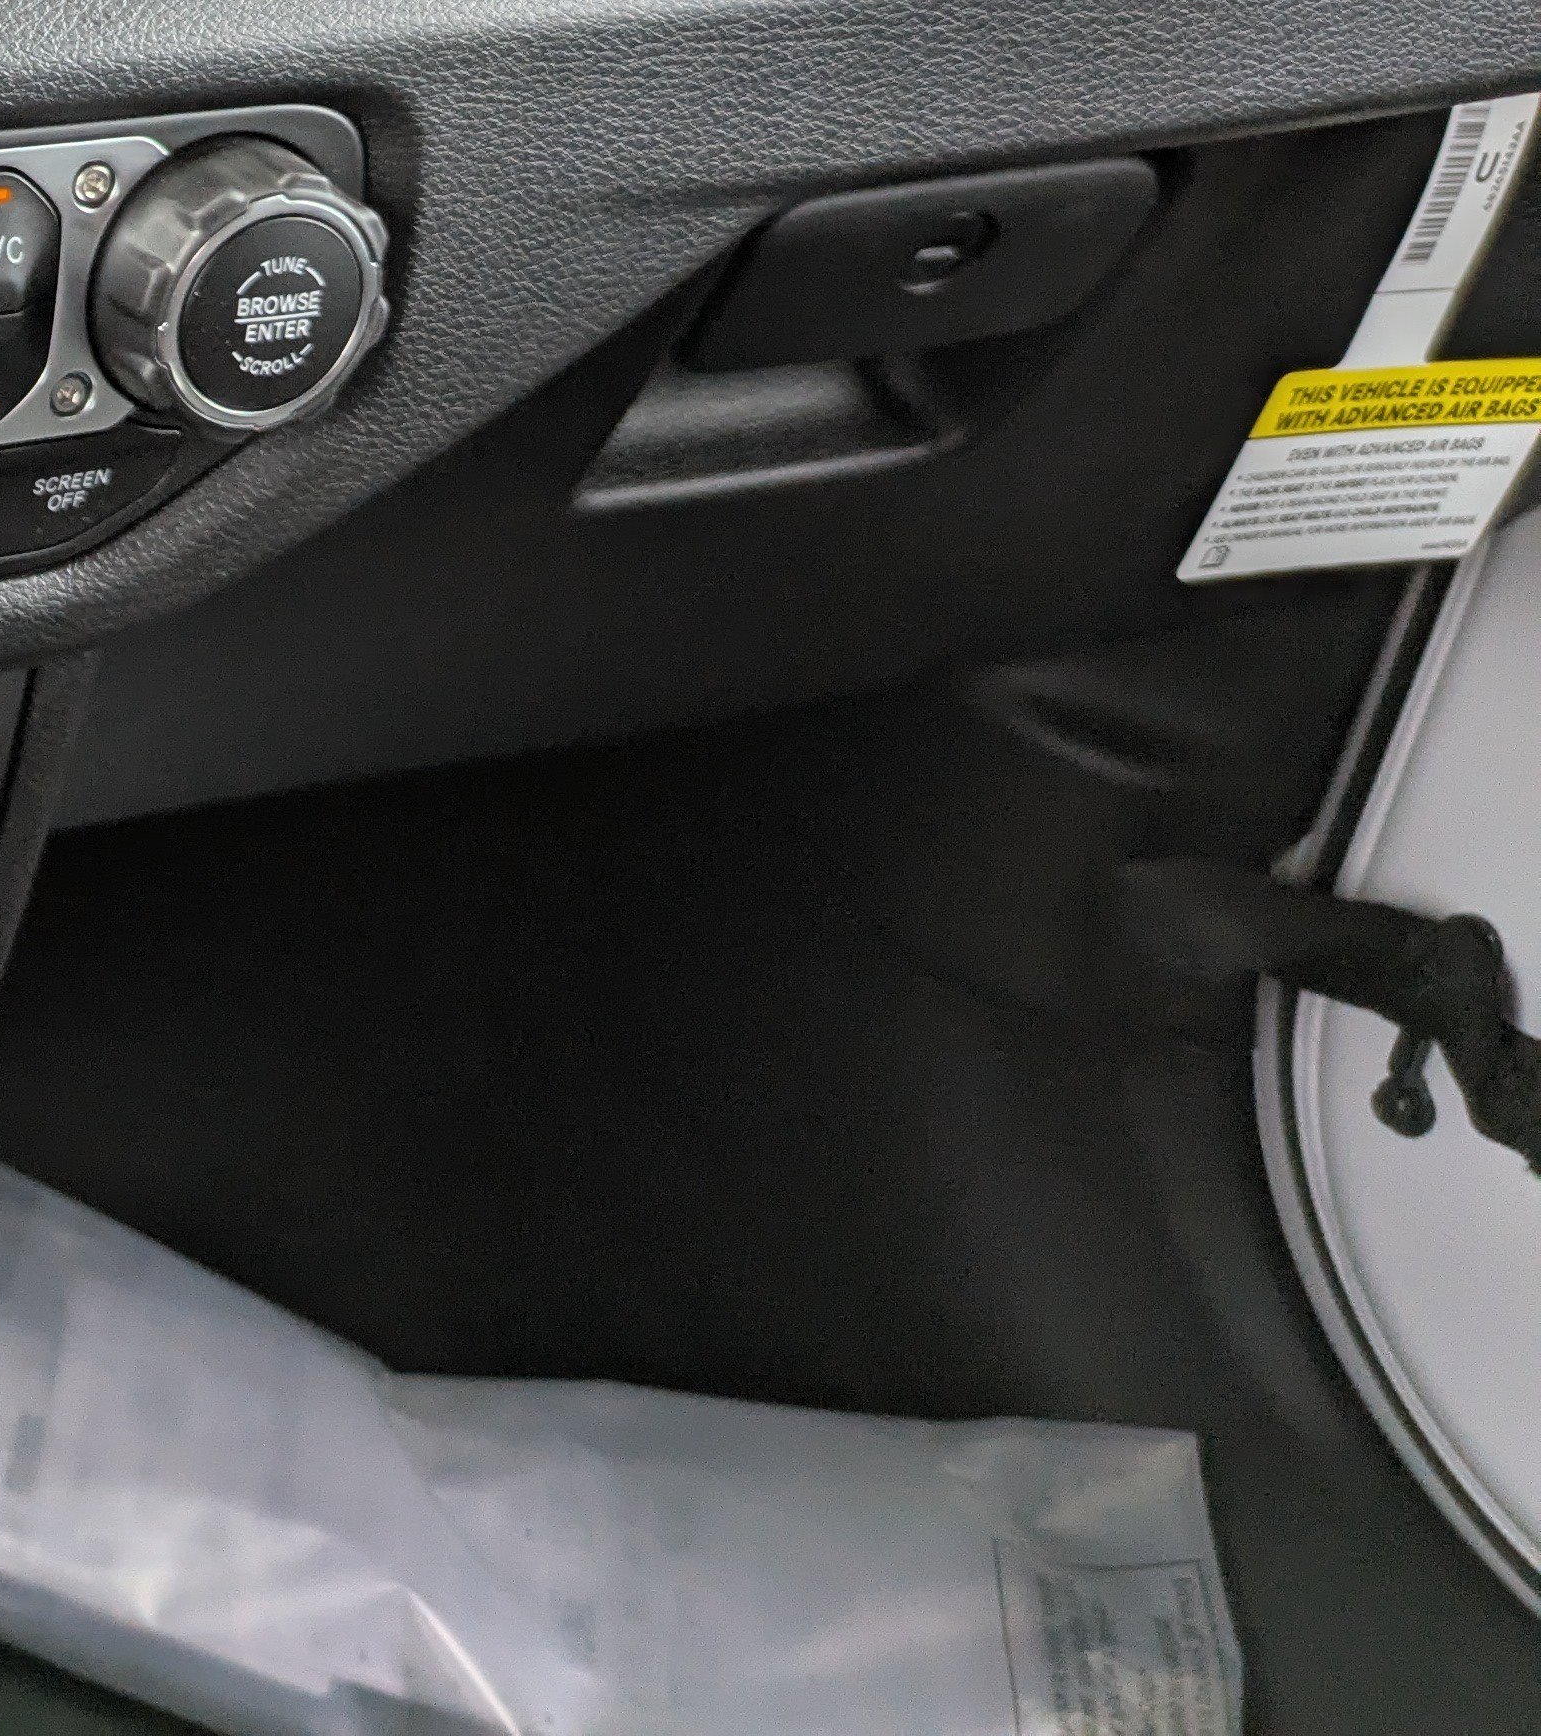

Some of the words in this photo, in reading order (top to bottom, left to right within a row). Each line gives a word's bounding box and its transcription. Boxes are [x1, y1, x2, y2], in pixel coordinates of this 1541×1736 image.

[260, 255, 308, 277] TUNE
[237, 290, 322, 317] BROWSE
[244, 319, 312, 343] ENTER
[239, 352, 305, 377] SCROLL
[1289, 385, 1337, 406] THIS
[1338, 378, 1425, 402] VEHICLE
[1426, 377, 1450, 397] IS
[1449, 374, 1541, 396] EQUIPPE
[1275, 409, 1328, 431] WITH
[1328, 402, 1444, 427] ADVANCED
[1444, 400, 1483, 420] AIR
[1484, 397, 1540, 417] BAGS
[33, 468, 110, 499] SCREEN
[46, 489, 87, 512] OFF
